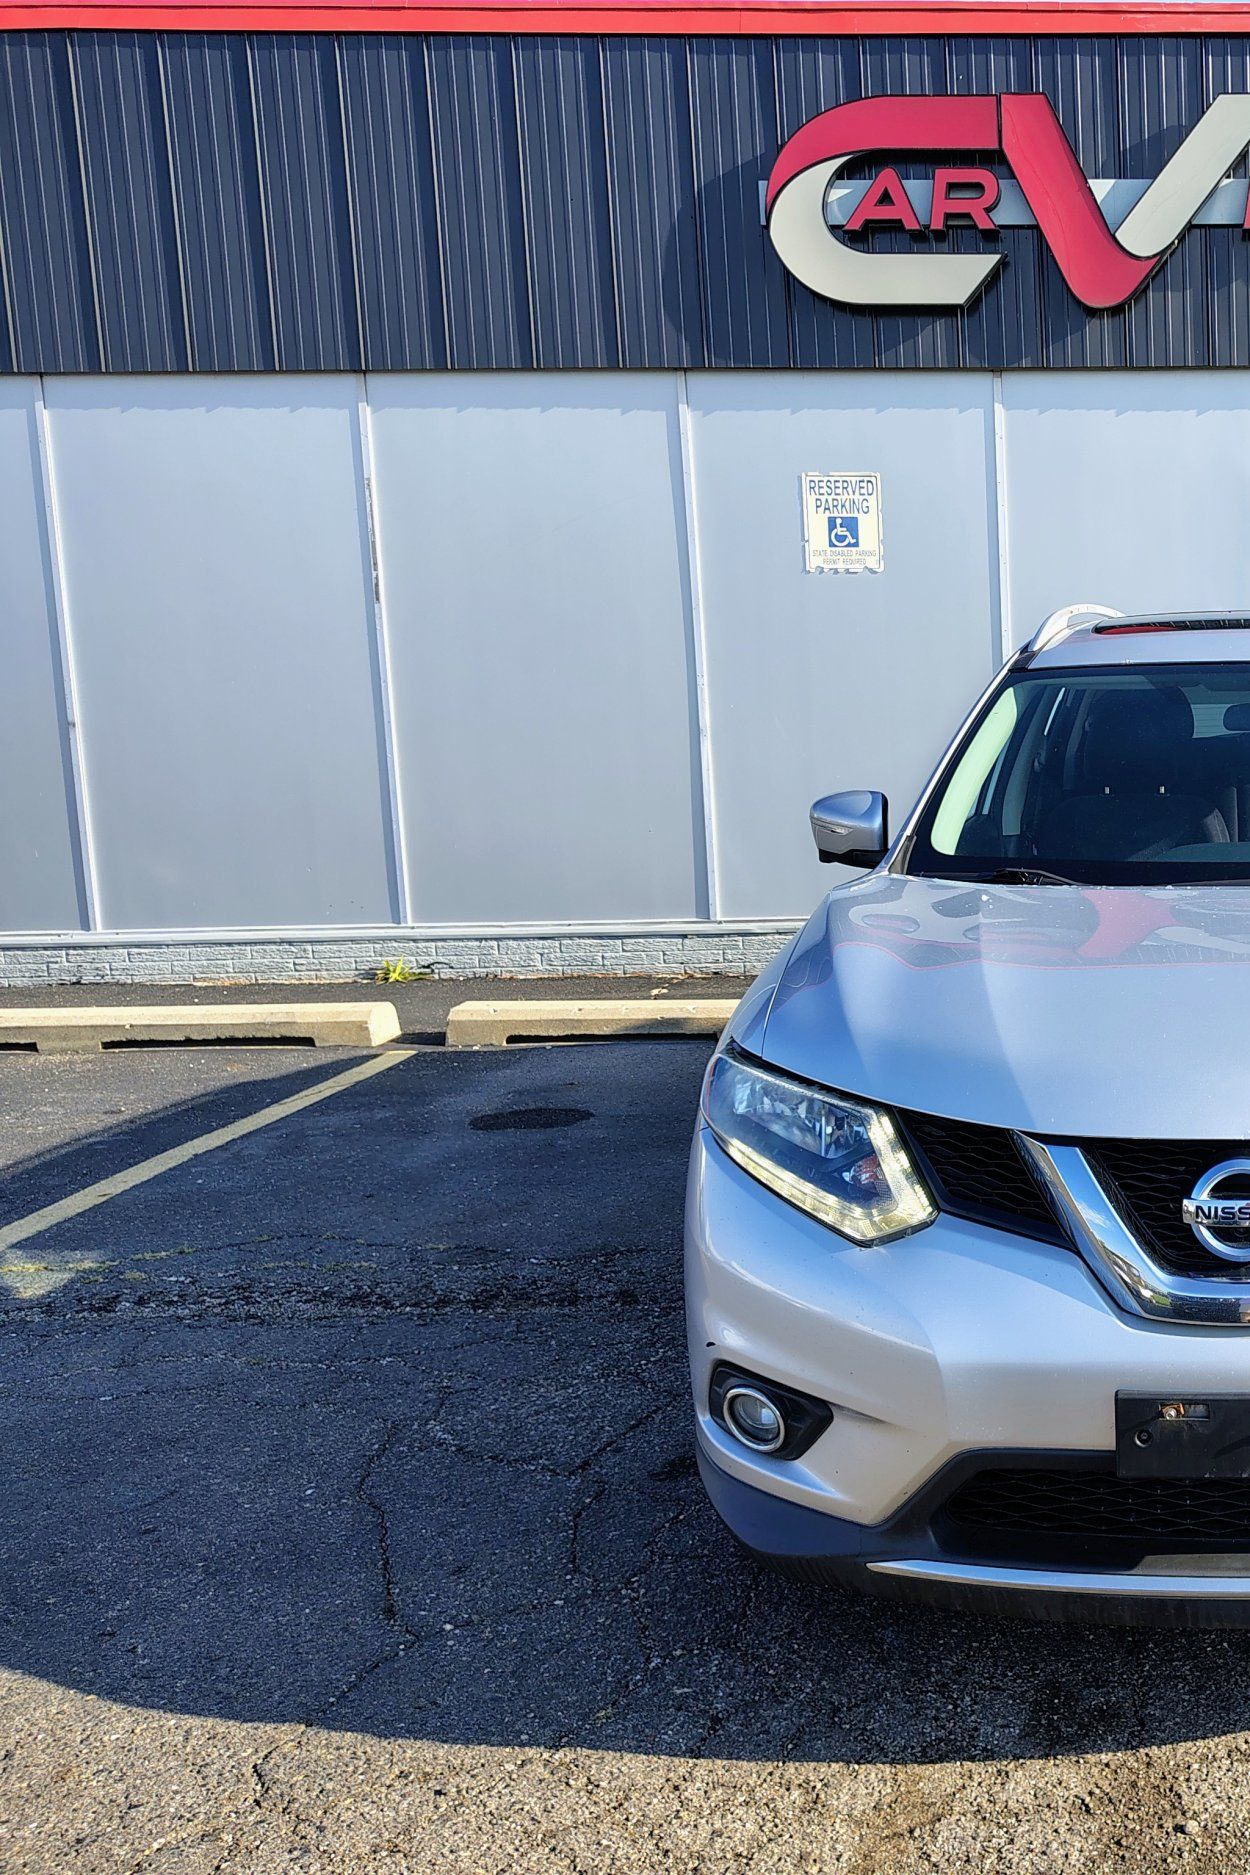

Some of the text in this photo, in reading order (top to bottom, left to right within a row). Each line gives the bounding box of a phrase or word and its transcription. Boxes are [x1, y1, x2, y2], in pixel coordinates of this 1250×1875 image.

[809, 479, 874, 496] RESERVED
[815, 498, 870, 514] PARKING
[812, 549, 877, 557] STATE DISABLED PARKING
[823, 558, 867, 566] PERMIT REQUIRED
